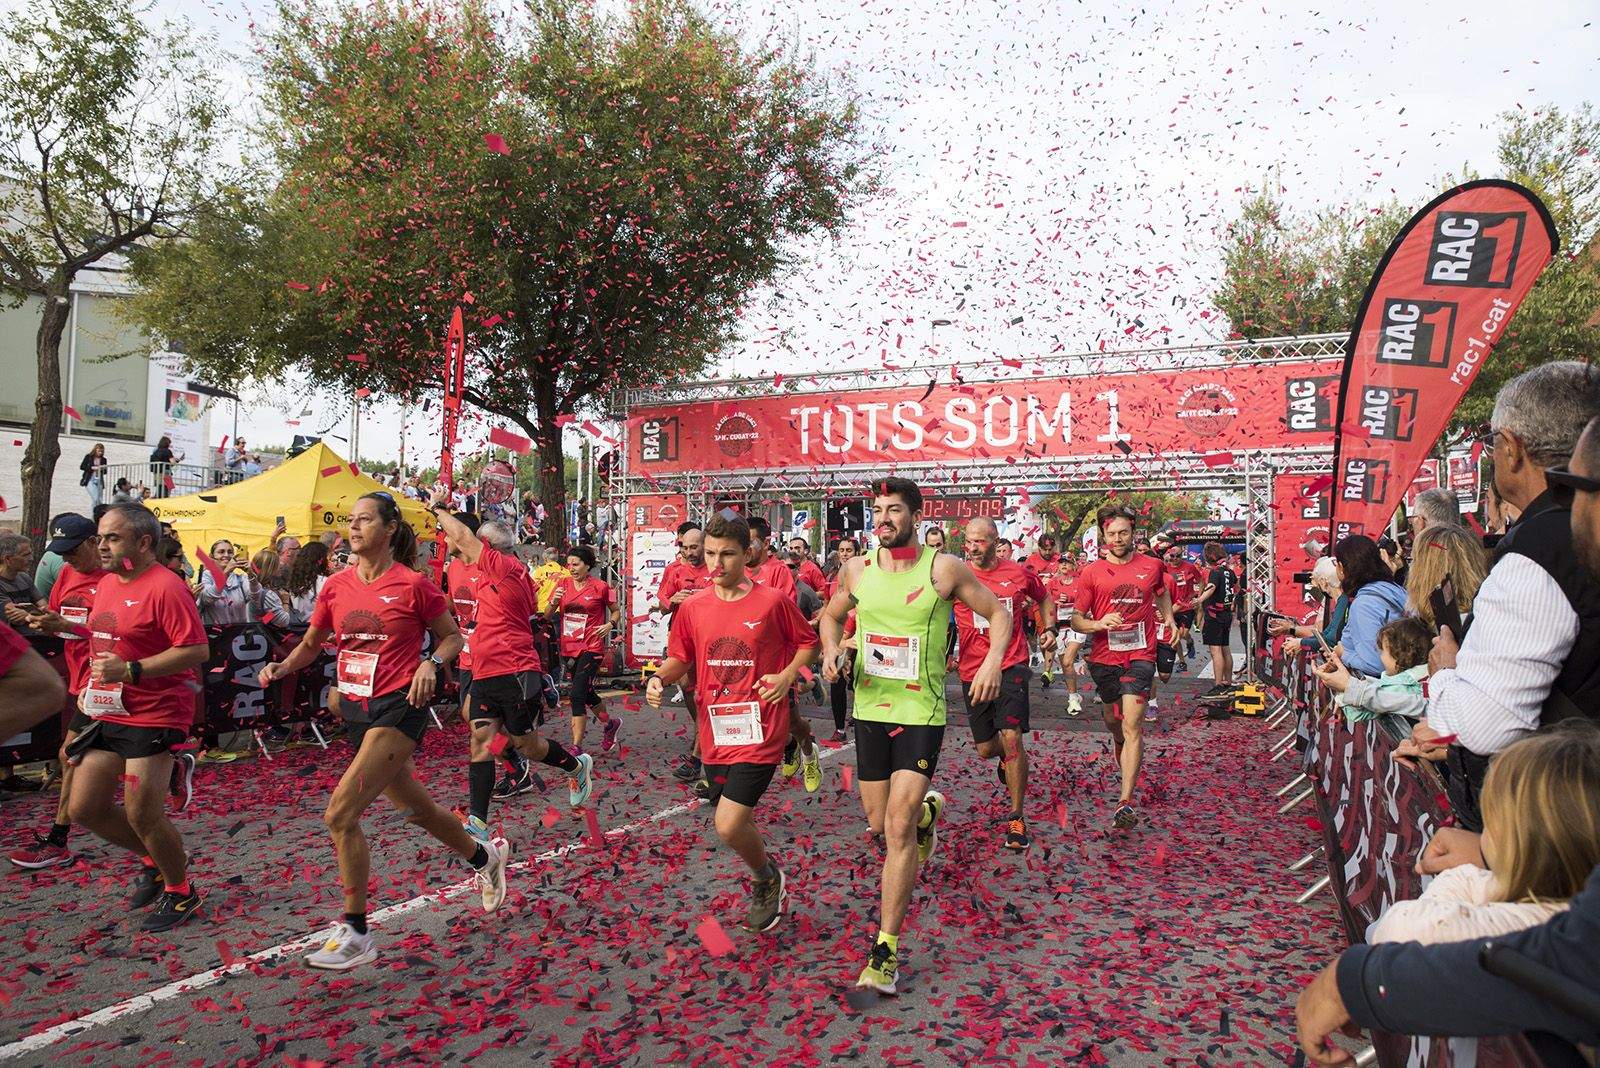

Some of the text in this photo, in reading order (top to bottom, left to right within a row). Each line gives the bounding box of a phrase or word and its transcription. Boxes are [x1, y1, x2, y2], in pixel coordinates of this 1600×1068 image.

[1431, 217, 1519, 283] RAC 1
[1382, 303, 1452, 363] RAC 1
[1450, 297, 1513, 386] rac1.cat
[790, 389, 1132, 455] TOTS SOM 1
[1289, 380, 1316, 430] RAC
[1362, 389, 1414, 437] RAC 1
[643, 421, 660, 460] RAC
[1344, 460, 1383, 501] RAC 1
[636, 507, 645, 525] RAC
[922, 500, 1002, 518] 02:15:09
[93, 695, 114, 705] 3122
[232, 633, 269, 719] RAC
